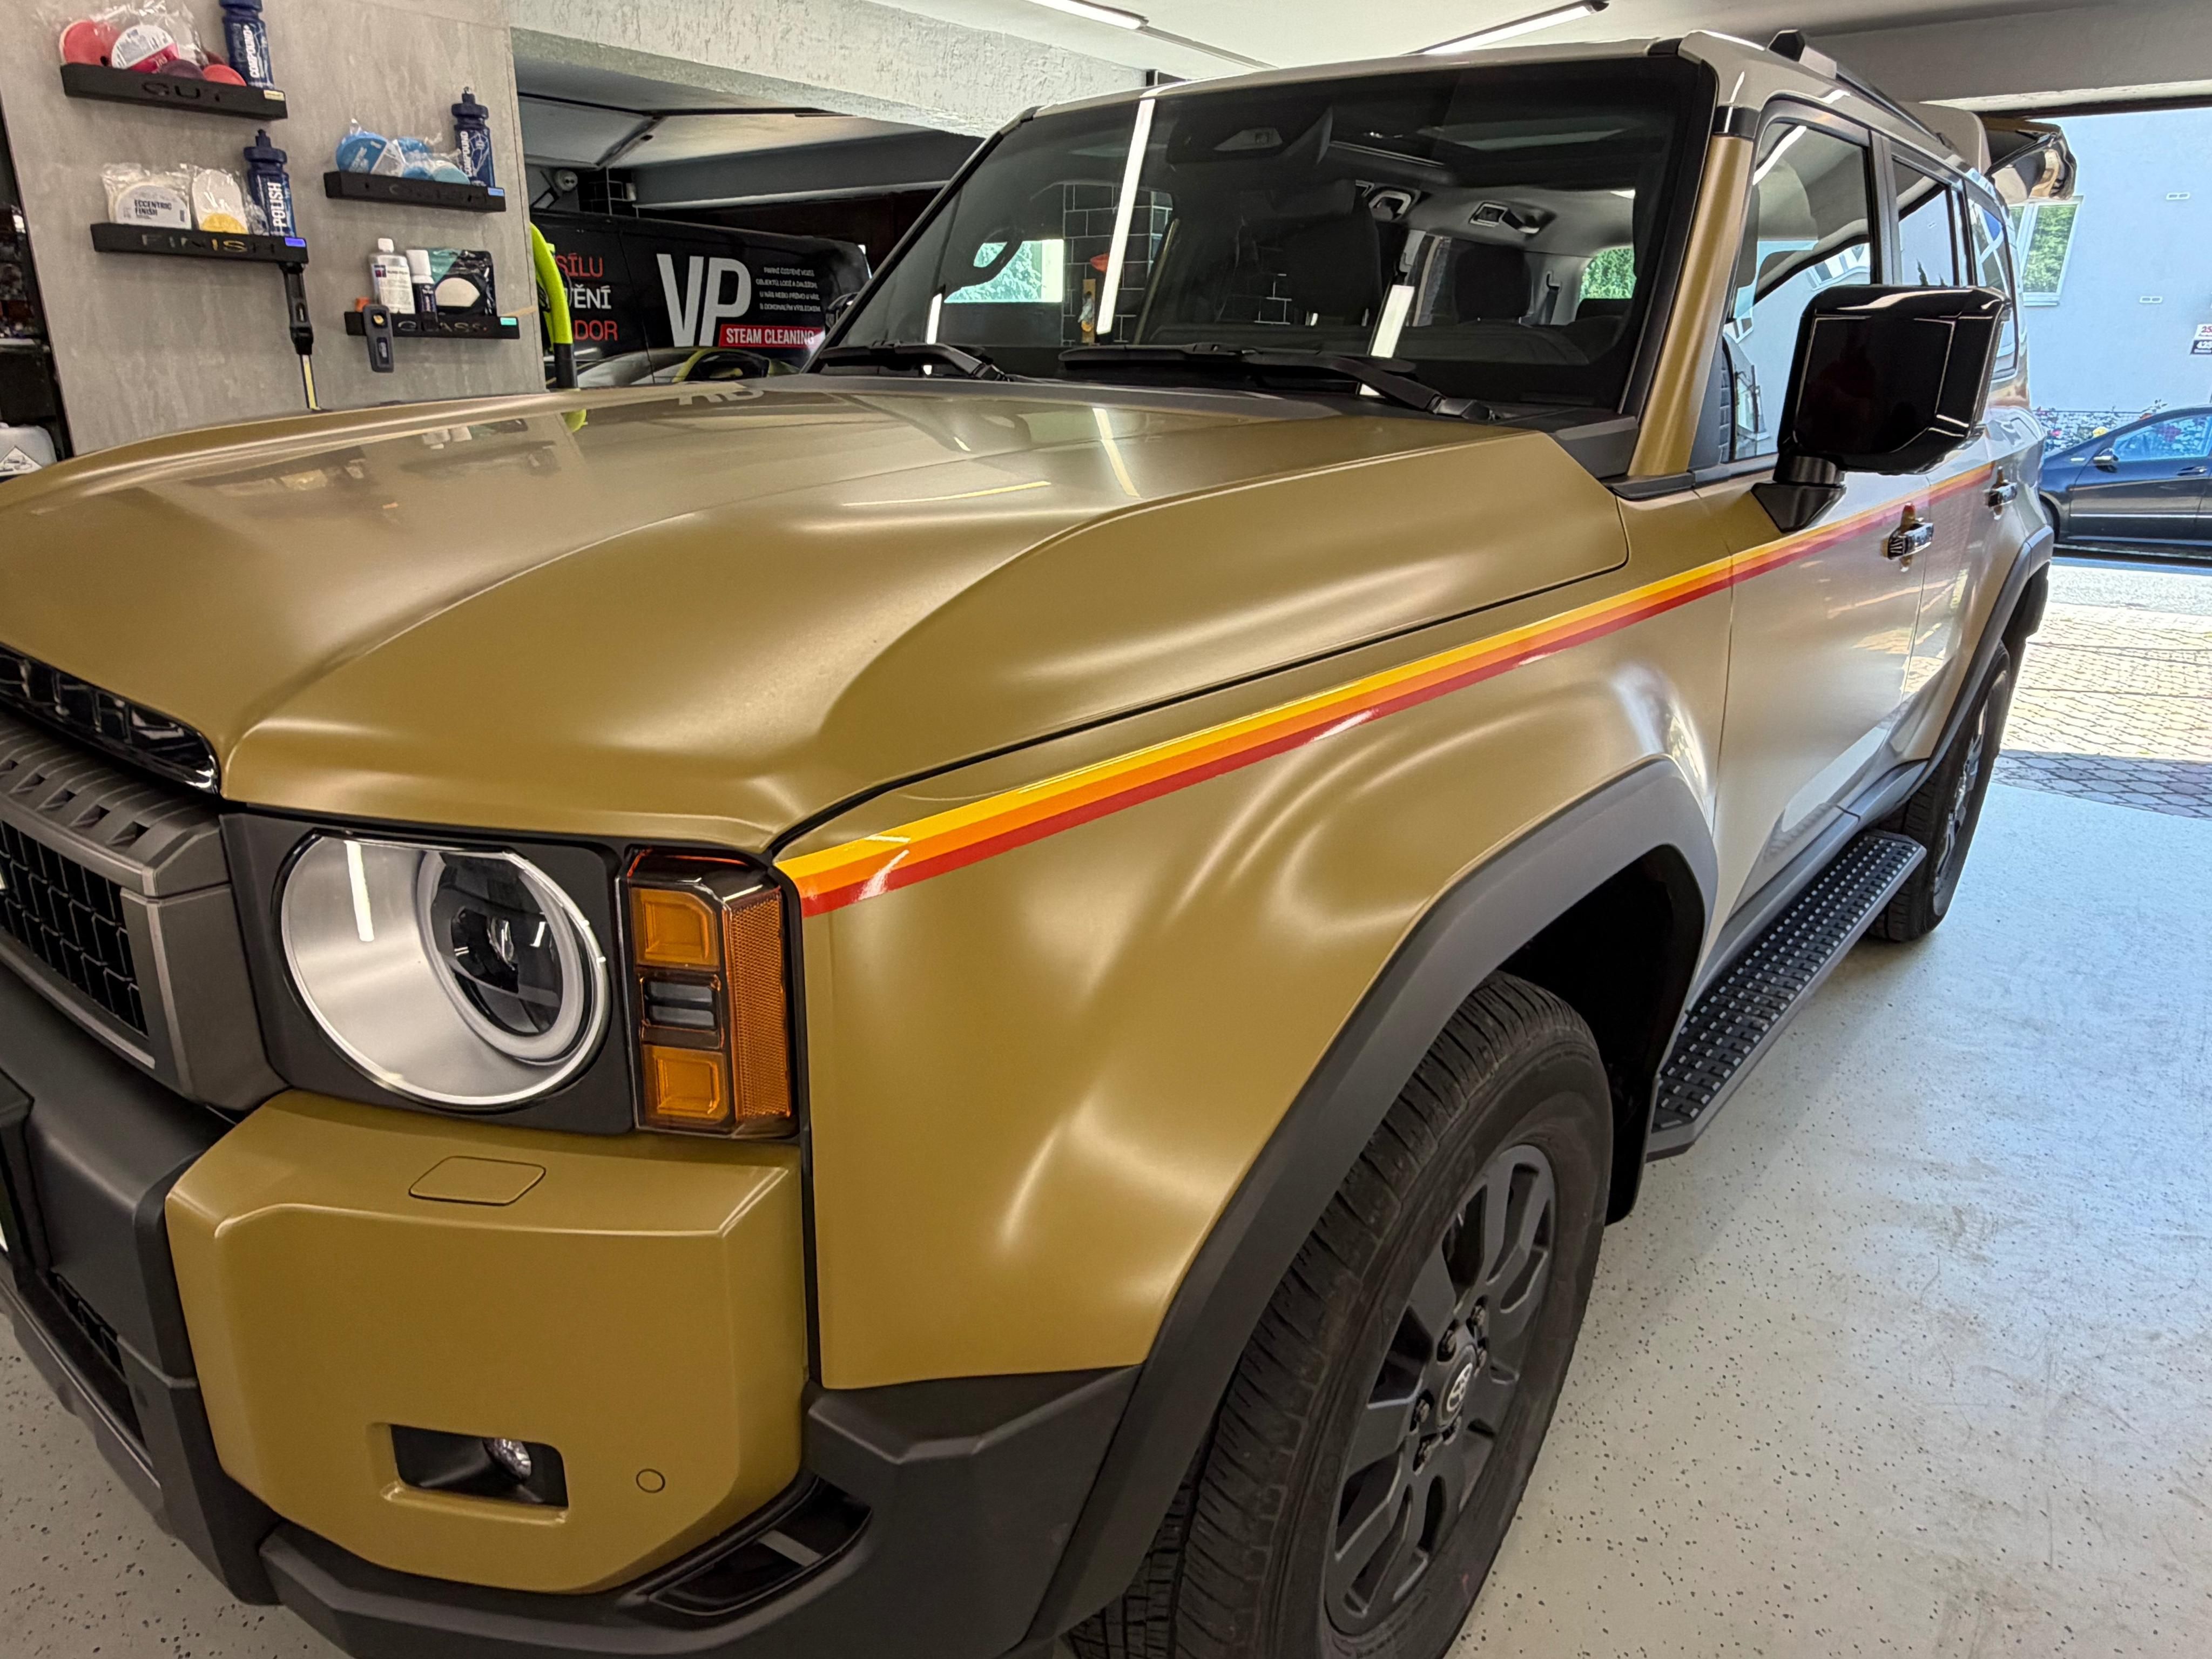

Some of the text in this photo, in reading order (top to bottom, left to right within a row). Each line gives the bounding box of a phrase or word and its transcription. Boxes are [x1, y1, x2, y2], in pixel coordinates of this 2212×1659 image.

[267, 181, 287, 227] POLISH
[556, 252, 604, 278] SÍLU
[656, 253, 752, 347] VP
[726, 327, 814, 345] STEAM CLEANING
